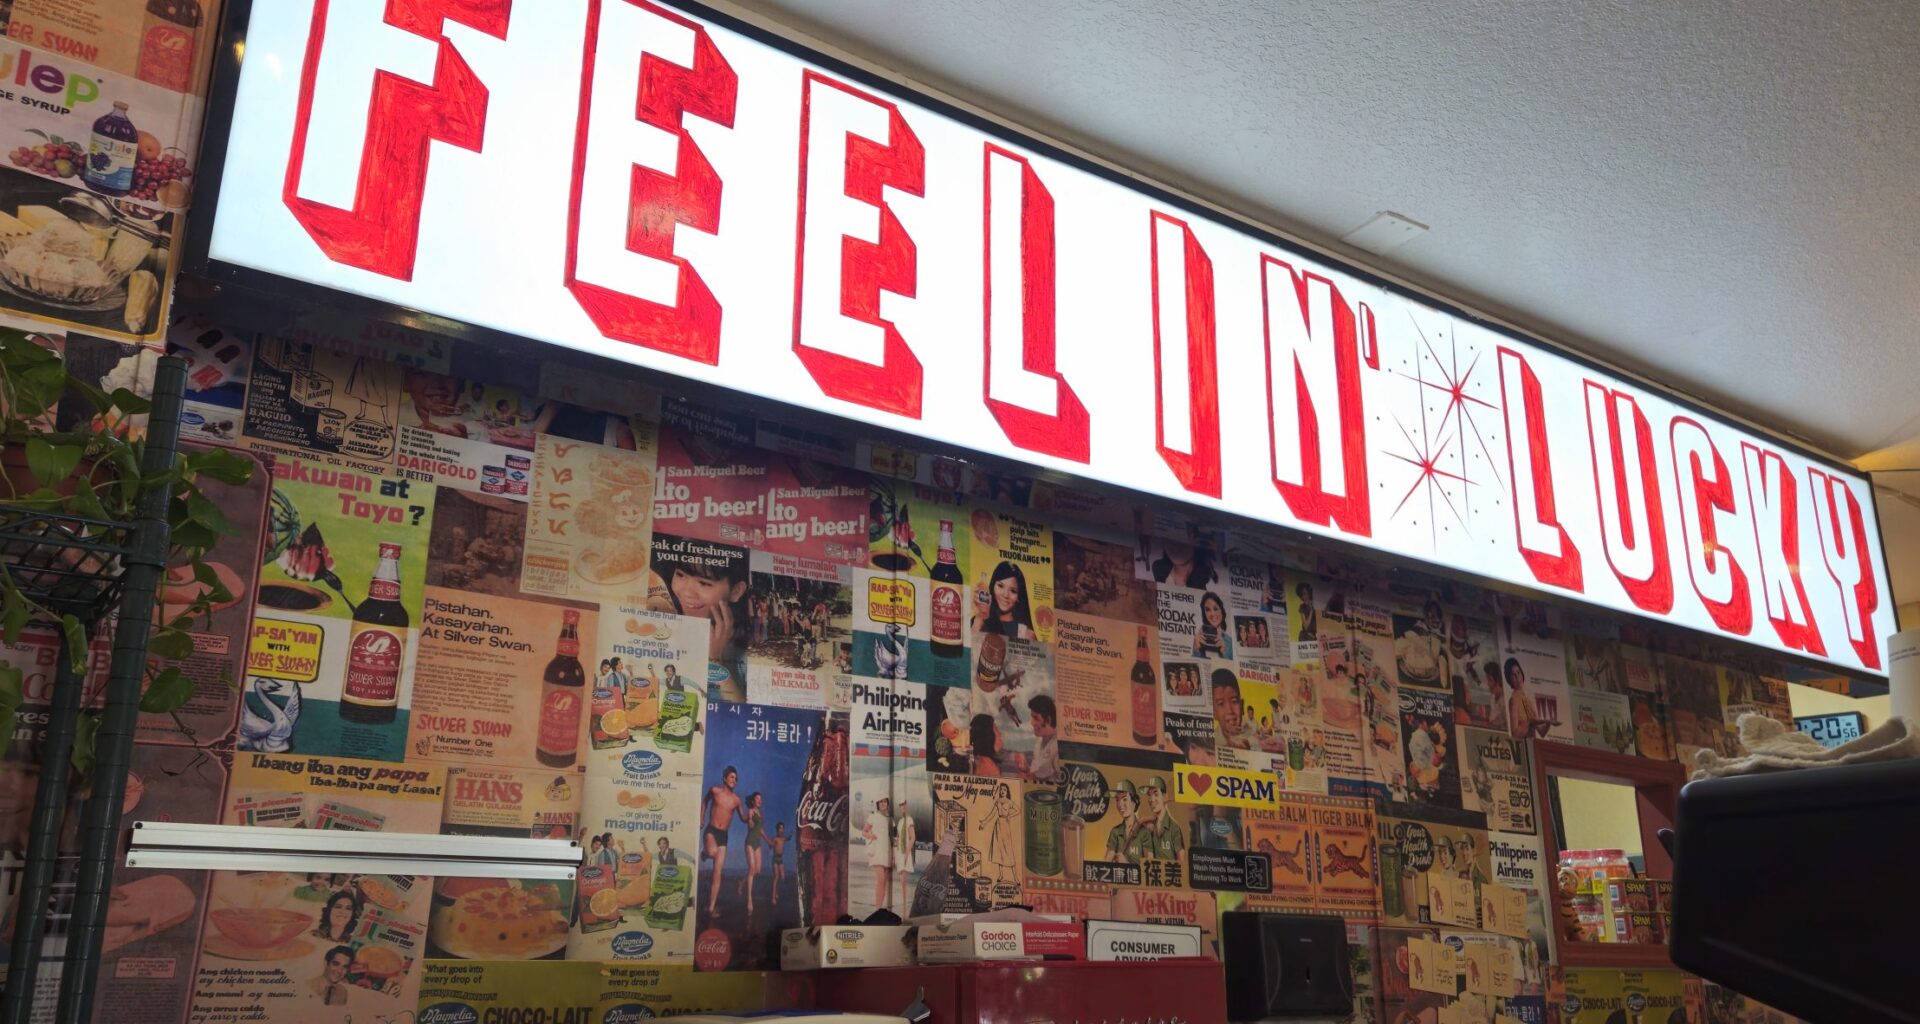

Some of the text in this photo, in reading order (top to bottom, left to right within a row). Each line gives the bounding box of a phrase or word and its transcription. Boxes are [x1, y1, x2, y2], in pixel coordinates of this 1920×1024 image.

[41, 31, 99, 62] SWAN
[21, 96, 71, 115] SYRUP
[284, 0, 1881, 672] FEELIN' LUCKY
[249, 408, 292, 422] BAGUIO
[323, 418, 342, 427] LION
[411, 428, 434, 439] drinking
[411, 435, 435, 446] creaming
[250, 442, 386, 474] INTERNATIONAL OIL FACTORY
[419, 451, 435, 460] whole
[396, 455, 477, 481] DARIGOLD
[668, 465, 765, 479] San Miguel Beer
[396, 468, 434, 484] IS BETTER
[380, 479, 410, 499] at
[777, 486, 865, 499] San Miguel Beer
[655, 496, 764, 523] ang beer!
[766, 515, 865, 541] ang beer!
[673, 541, 743, 559] of freshness
[1010, 542, 1029, 553] Royal
[656, 553, 730, 568] you can see!
[772, 555, 797, 568] Habang
[1171, 592, 1195, 603] HERE!
[425, 598, 494, 620] Pistahan.
[649, 610, 661, 618] the
[1158, 608, 1196, 625] KODAK
[424, 612, 513, 636] Kasayahan.
[1057, 618, 1097, 634] Pistahan.
[1158, 622, 1197, 635] INSTANT
[421, 627, 535, 653] At Silver Swan.
[642, 639, 656, 648] give
[1057, 630, 1110, 647] Kasayahan.
[267, 643, 290, 652] WITH
[1058, 641, 1069, 650] At
[1070, 642, 1095, 655] Silver
[1096, 647, 1123, 660] Swan.
[275, 655, 316, 672] SWAN
[350, 670, 396, 687] SILVER SWAN
[771, 679, 820, 691] MILKMAID
[1062, 705, 1118, 723] SILVER SWAN
[416, 713, 512, 738] SILVER SWAN
[862, 711, 923, 736] Airlines
[1074, 721, 1095, 731] Number
[1165, 717, 1195, 729] Peak of
[1176, 728, 1205, 738] you can
[1842, 727, 1858, 738] 56
[436, 735, 493, 748] Number One
[1477, 744, 1512, 761] VOLTES
[251, 753, 430, 783] Ibang iba ang papa
[467, 771, 494, 779] QUICK
[623, 770, 661, 780] Fruit Drinks
[1071, 766, 1099, 783] Your
[376, 782, 441, 796] ang Lasa!
[454, 778, 523, 804] HANS
[1065, 784, 1101, 800] Health
[1177, 772, 1275, 802] I SPAM
[453, 800, 522, 811] GELATIN GULAMAN
[1072, 800, 1106, 816] Drink
[543, 812, 573, 824] HANS
[635, 812, 650, 820] give
[1030, 807, 1059, 821] MILO
[1280, 808, 1308, 824] BALM
[1312, 809, 1374, 829] TIGER BALM
[1406, 825, 1426, 839] Your
[1162, 841, 1171, 850] LO
[1402, 840, 1428, 854] Health
[1489, 840, 1538, 861] Philippine
[1192, 854, 1236, 865] Employees Must
[1408, 854, 1432, 867] Drink
[1208, 866, 1226, 874] Hands
[1226, 866, 1244, 875] Before
[1496, 863, 1534, 879] Airlines
[1193, 874, 1220, 883] Returning
[1626, 883, 1646, 893] SPAM
[837, 932, 862, 940] NITRILE
[981, 930, 1016, 941] Gordon
[981, 941, 1017, 951] CHOICE
[1110, 941, 1176, 955] CONSUMER
[200, 967, 286, 978] Ang chicken noodle
[427, 964, 484, 976] What goes into
[609, 968, 660, 978] What goes into
[199, 975, 296, 988] ay chicken noodle.
[424, 975, 482, 985] every drop of
[608, 977, 659, 987] every drop of
[195, 990, 212, 999] Ang
[212, 990, 244, 998] mami
[193, 1005, 265, 1013] Ang caldo
[420, 1007, 593, 1024] Magnolia CHOCO-LAIT
[605, 1008, 652, 1024] Magnolia
[192, 1013, 210, 1022] ay
